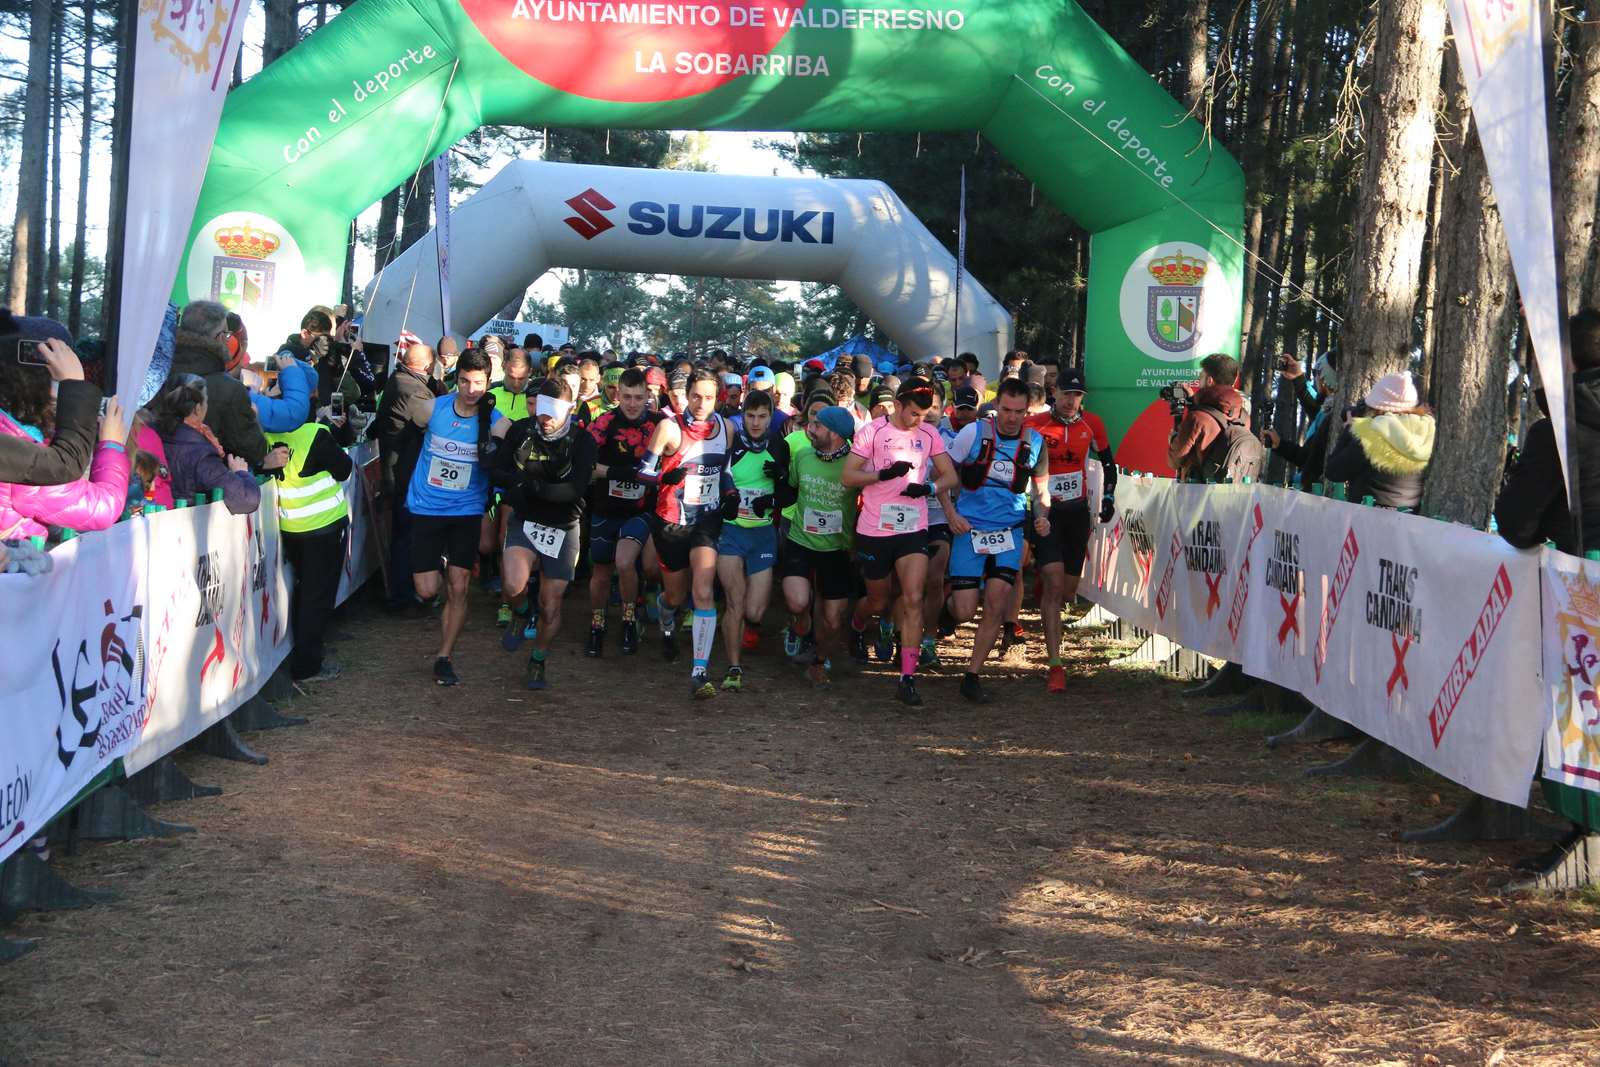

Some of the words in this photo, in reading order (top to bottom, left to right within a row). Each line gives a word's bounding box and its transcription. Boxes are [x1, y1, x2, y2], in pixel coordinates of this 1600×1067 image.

[511, 0, 720, 26] AYUNTAMIENTO
[729, 6, 765, 27] DE
[773, 7, 966, 31] VALDEFRESNO
[634, 51, 667, 74] LA
[674, 52, 830, 77] SOBARRIBA
[283, 126, 321, 163] Con
[328, 98, 347, 123] el
[353, 45, 436, 103] deporte
[1035, 65, 1075, 96] Con
[1082, 99, 1106, 116] el
[1107, 117, 1173, 188] deporte
[627, 201, 835, 244] SUZUKI
[1141, 368, 1203, 377] AYUNTAMIENT
[1136, 379, 1148, 387] DE
[440, 468, 458, 480] 20
[699, 484, 713, 494] 17
[1055, 480, 1078, 491] 485
[818, 517, 827, 527] 9
[897, 512, 905, 523] 3
[530, 530, 556, 546] 413
[980, 534, 1005, 545] 463
[1379, 558, 1418, 603] TRANS
[1366, 591, 1422, 643] CANDAMIA
